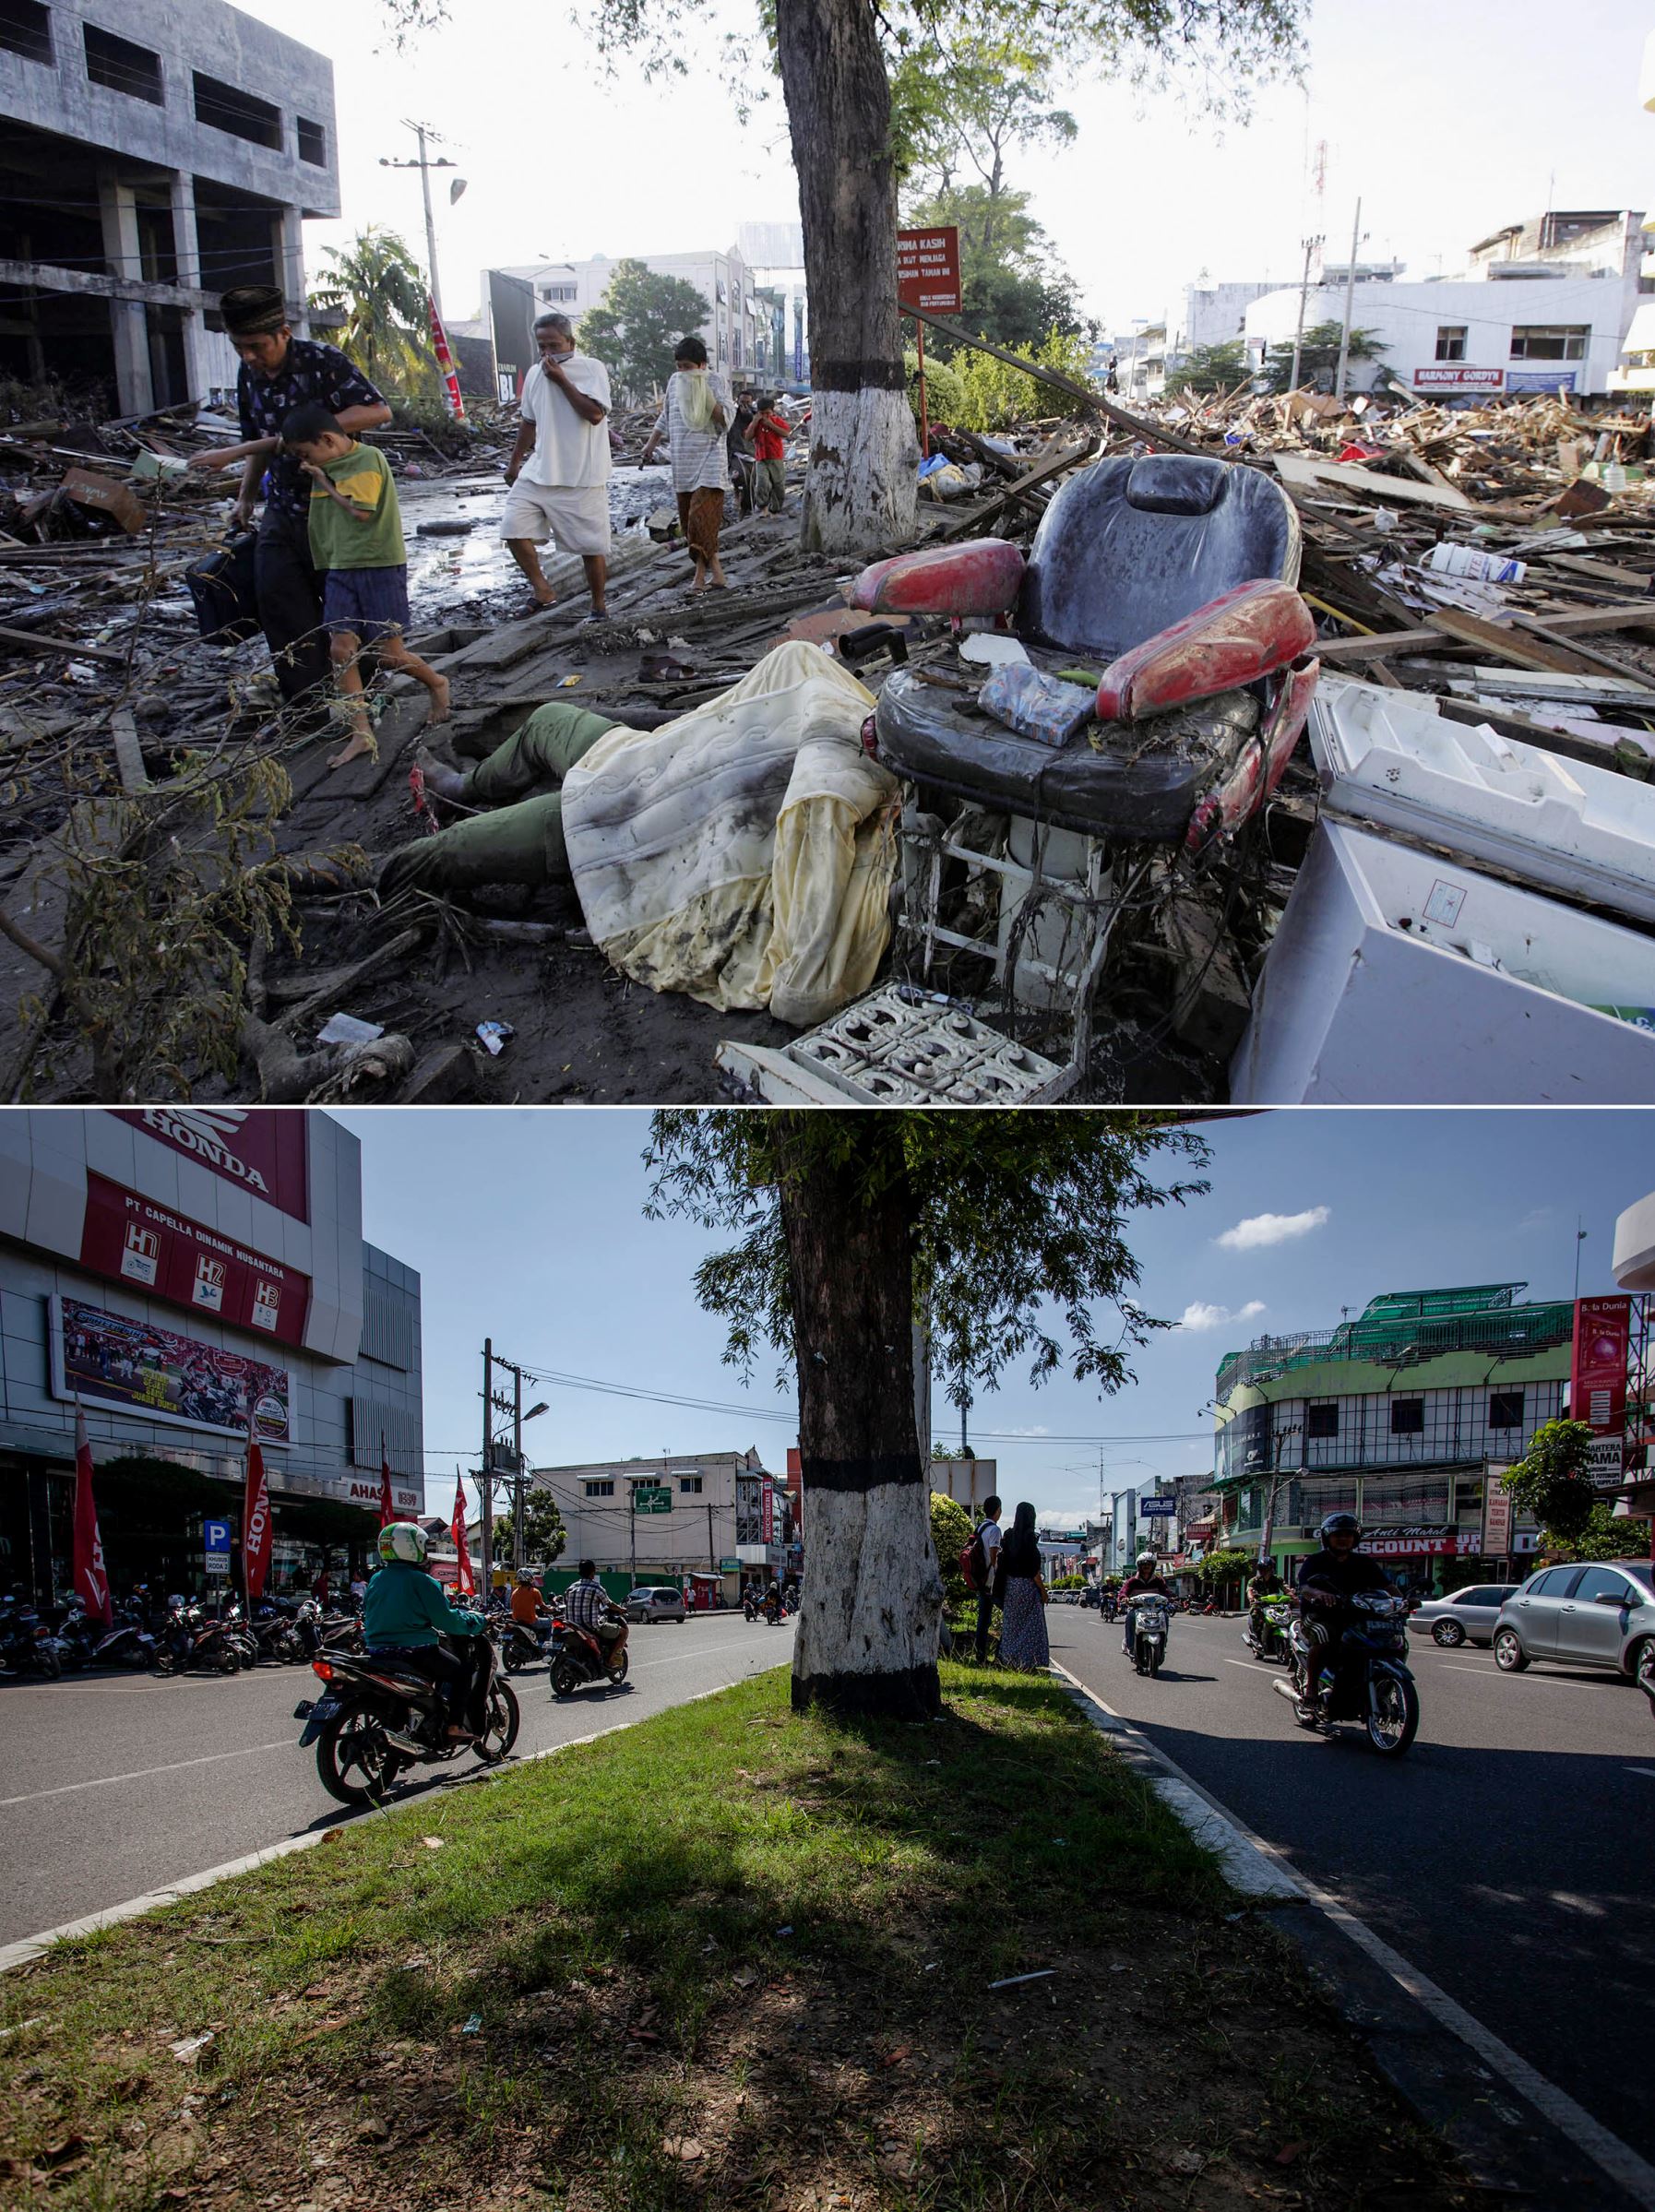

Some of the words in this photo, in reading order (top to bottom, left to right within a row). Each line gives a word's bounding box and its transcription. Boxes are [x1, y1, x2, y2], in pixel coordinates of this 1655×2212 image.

[920, 238, 946, 249] KASIH
[920, 254, 946, 264] MENJAGA
[921, 268, 941, 278] TAMAN
[1419, 370, 1462, 381] HARMONY
[1463, 370, 1499, 381] GORDYN
[142, 1109, 269, 1194] HONDA
[125, 1196, 141, 1212] PT
[145, 1207, 193, 1237] CAPELLA
[196, 1230, 233, 1256] DINAMIK
[236, 1250, 284, 1280] NUSANTARA
[127, 1223, 158, 1260] H1
[197, 1255, 225, 1287] H2
[256, 1281, 280, 1308] H3
[1601, 1301, 1627, 1312] Dunia
[1144, 1500, 1173, 1508] ASUS
[209, 1525, 226, 1546] P
[1363, 1528, 1399, 1539] Anti
[1402, 1525, 1449, 1537] Mahal
